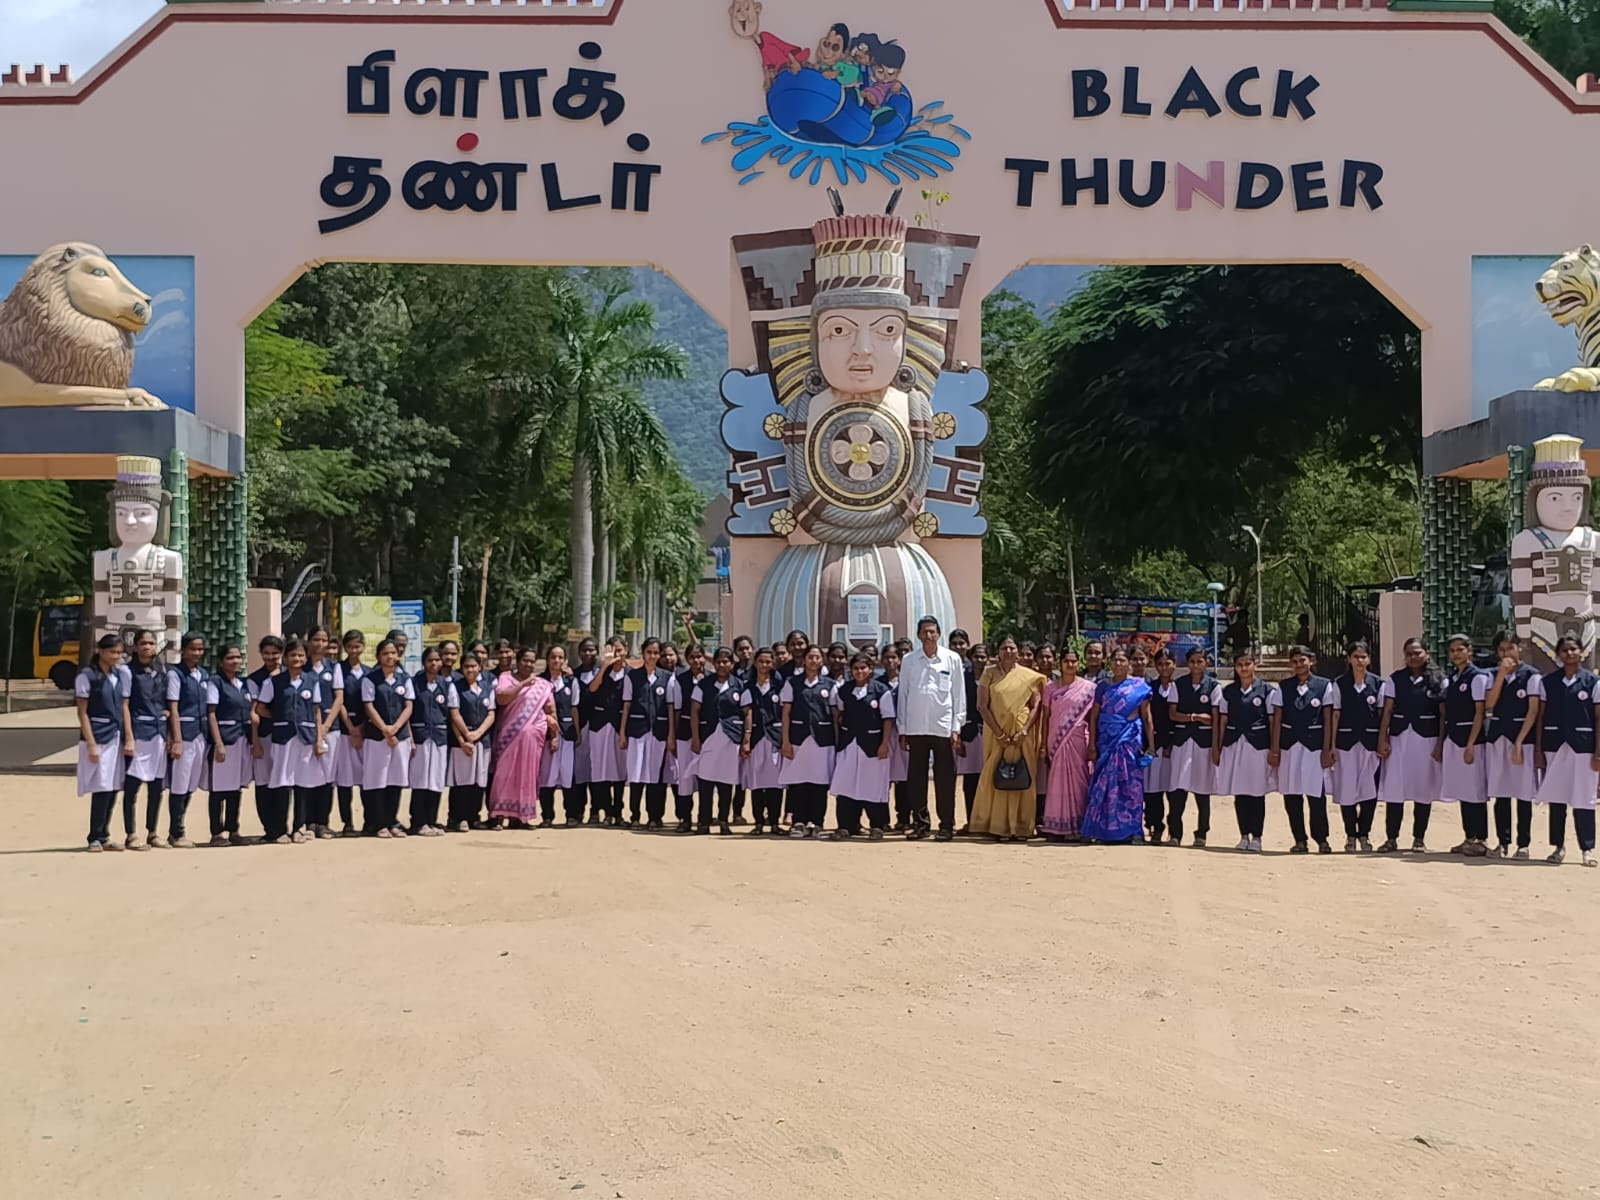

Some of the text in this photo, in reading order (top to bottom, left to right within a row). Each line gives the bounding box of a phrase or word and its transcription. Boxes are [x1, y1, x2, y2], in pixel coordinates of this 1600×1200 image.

[346, 41, 626, 127] பிளாக்
[1071, 65, 1321, 121] BLACK
[317, 132, 662, 235] தண்டர்
[1003, 157, 1385, 213] THUNDER
